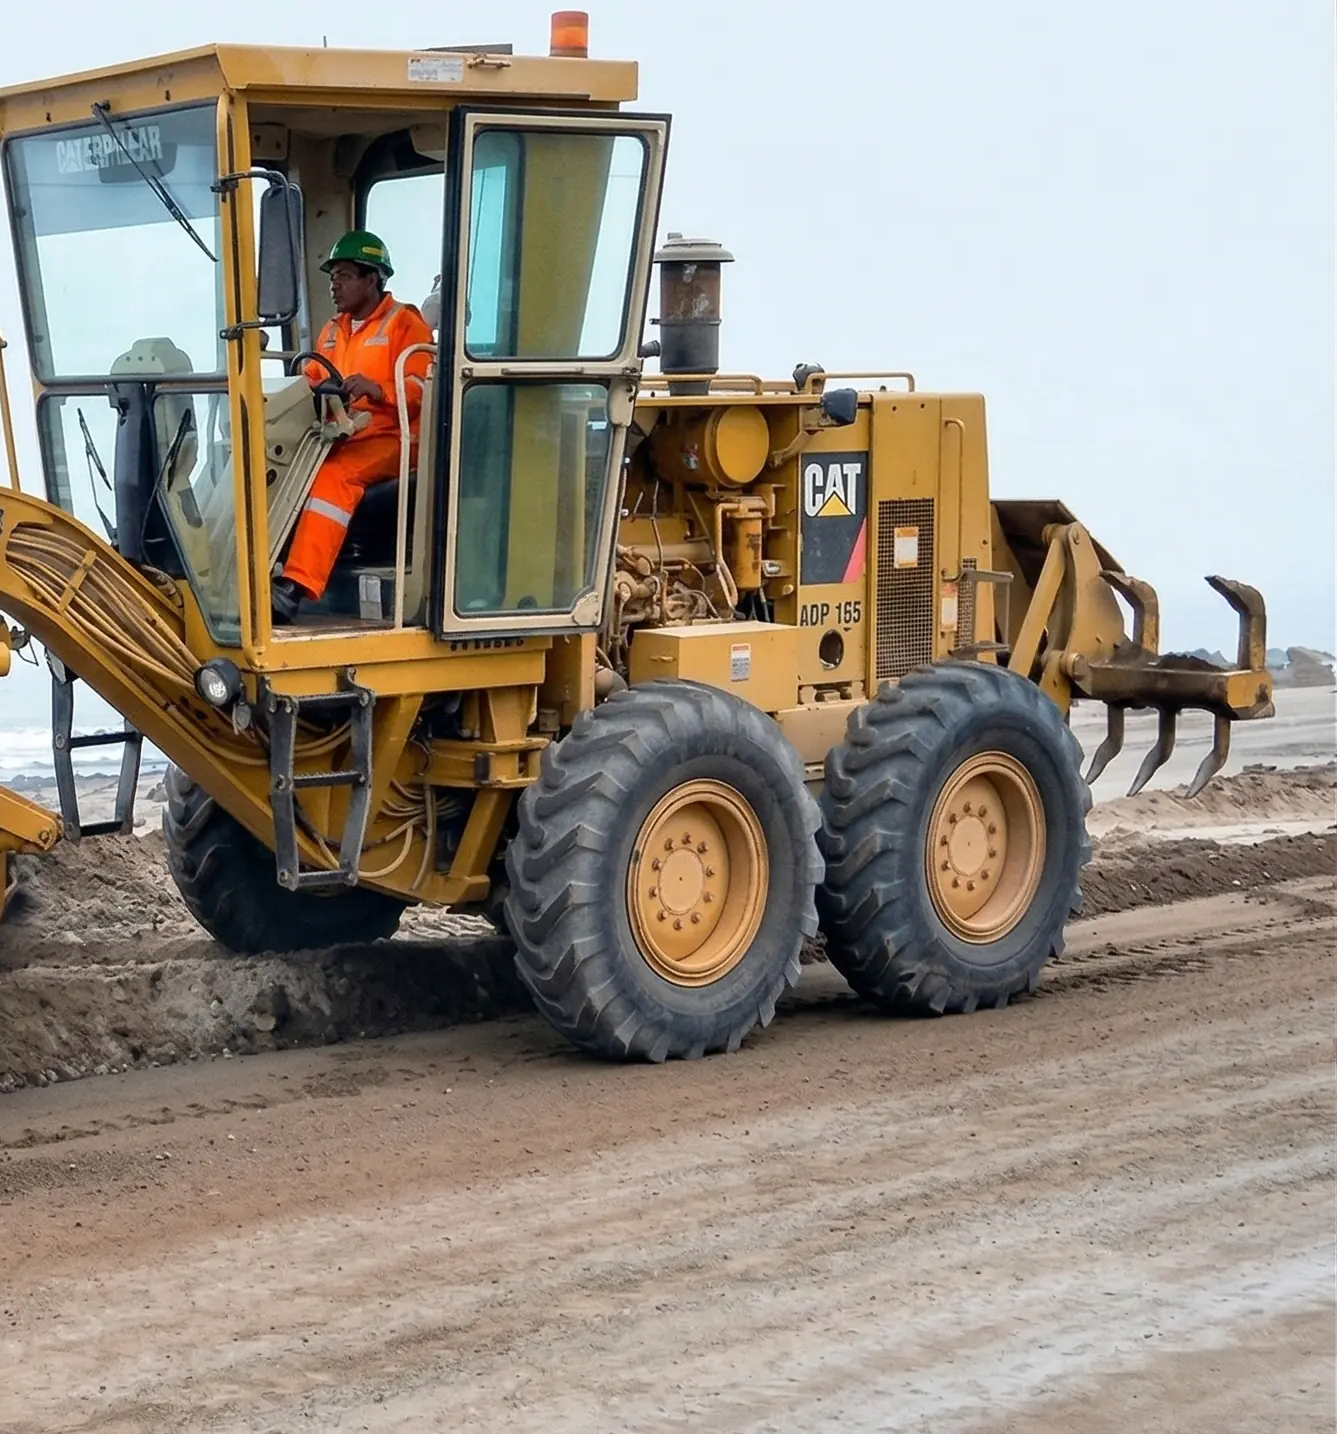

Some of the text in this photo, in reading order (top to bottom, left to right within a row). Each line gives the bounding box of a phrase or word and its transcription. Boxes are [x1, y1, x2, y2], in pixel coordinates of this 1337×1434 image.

[56, 125, 163, 174] CATERPILLAR
[804, 463, 862, 517] CAT
[800, 601, 861, 627] ADP 165
